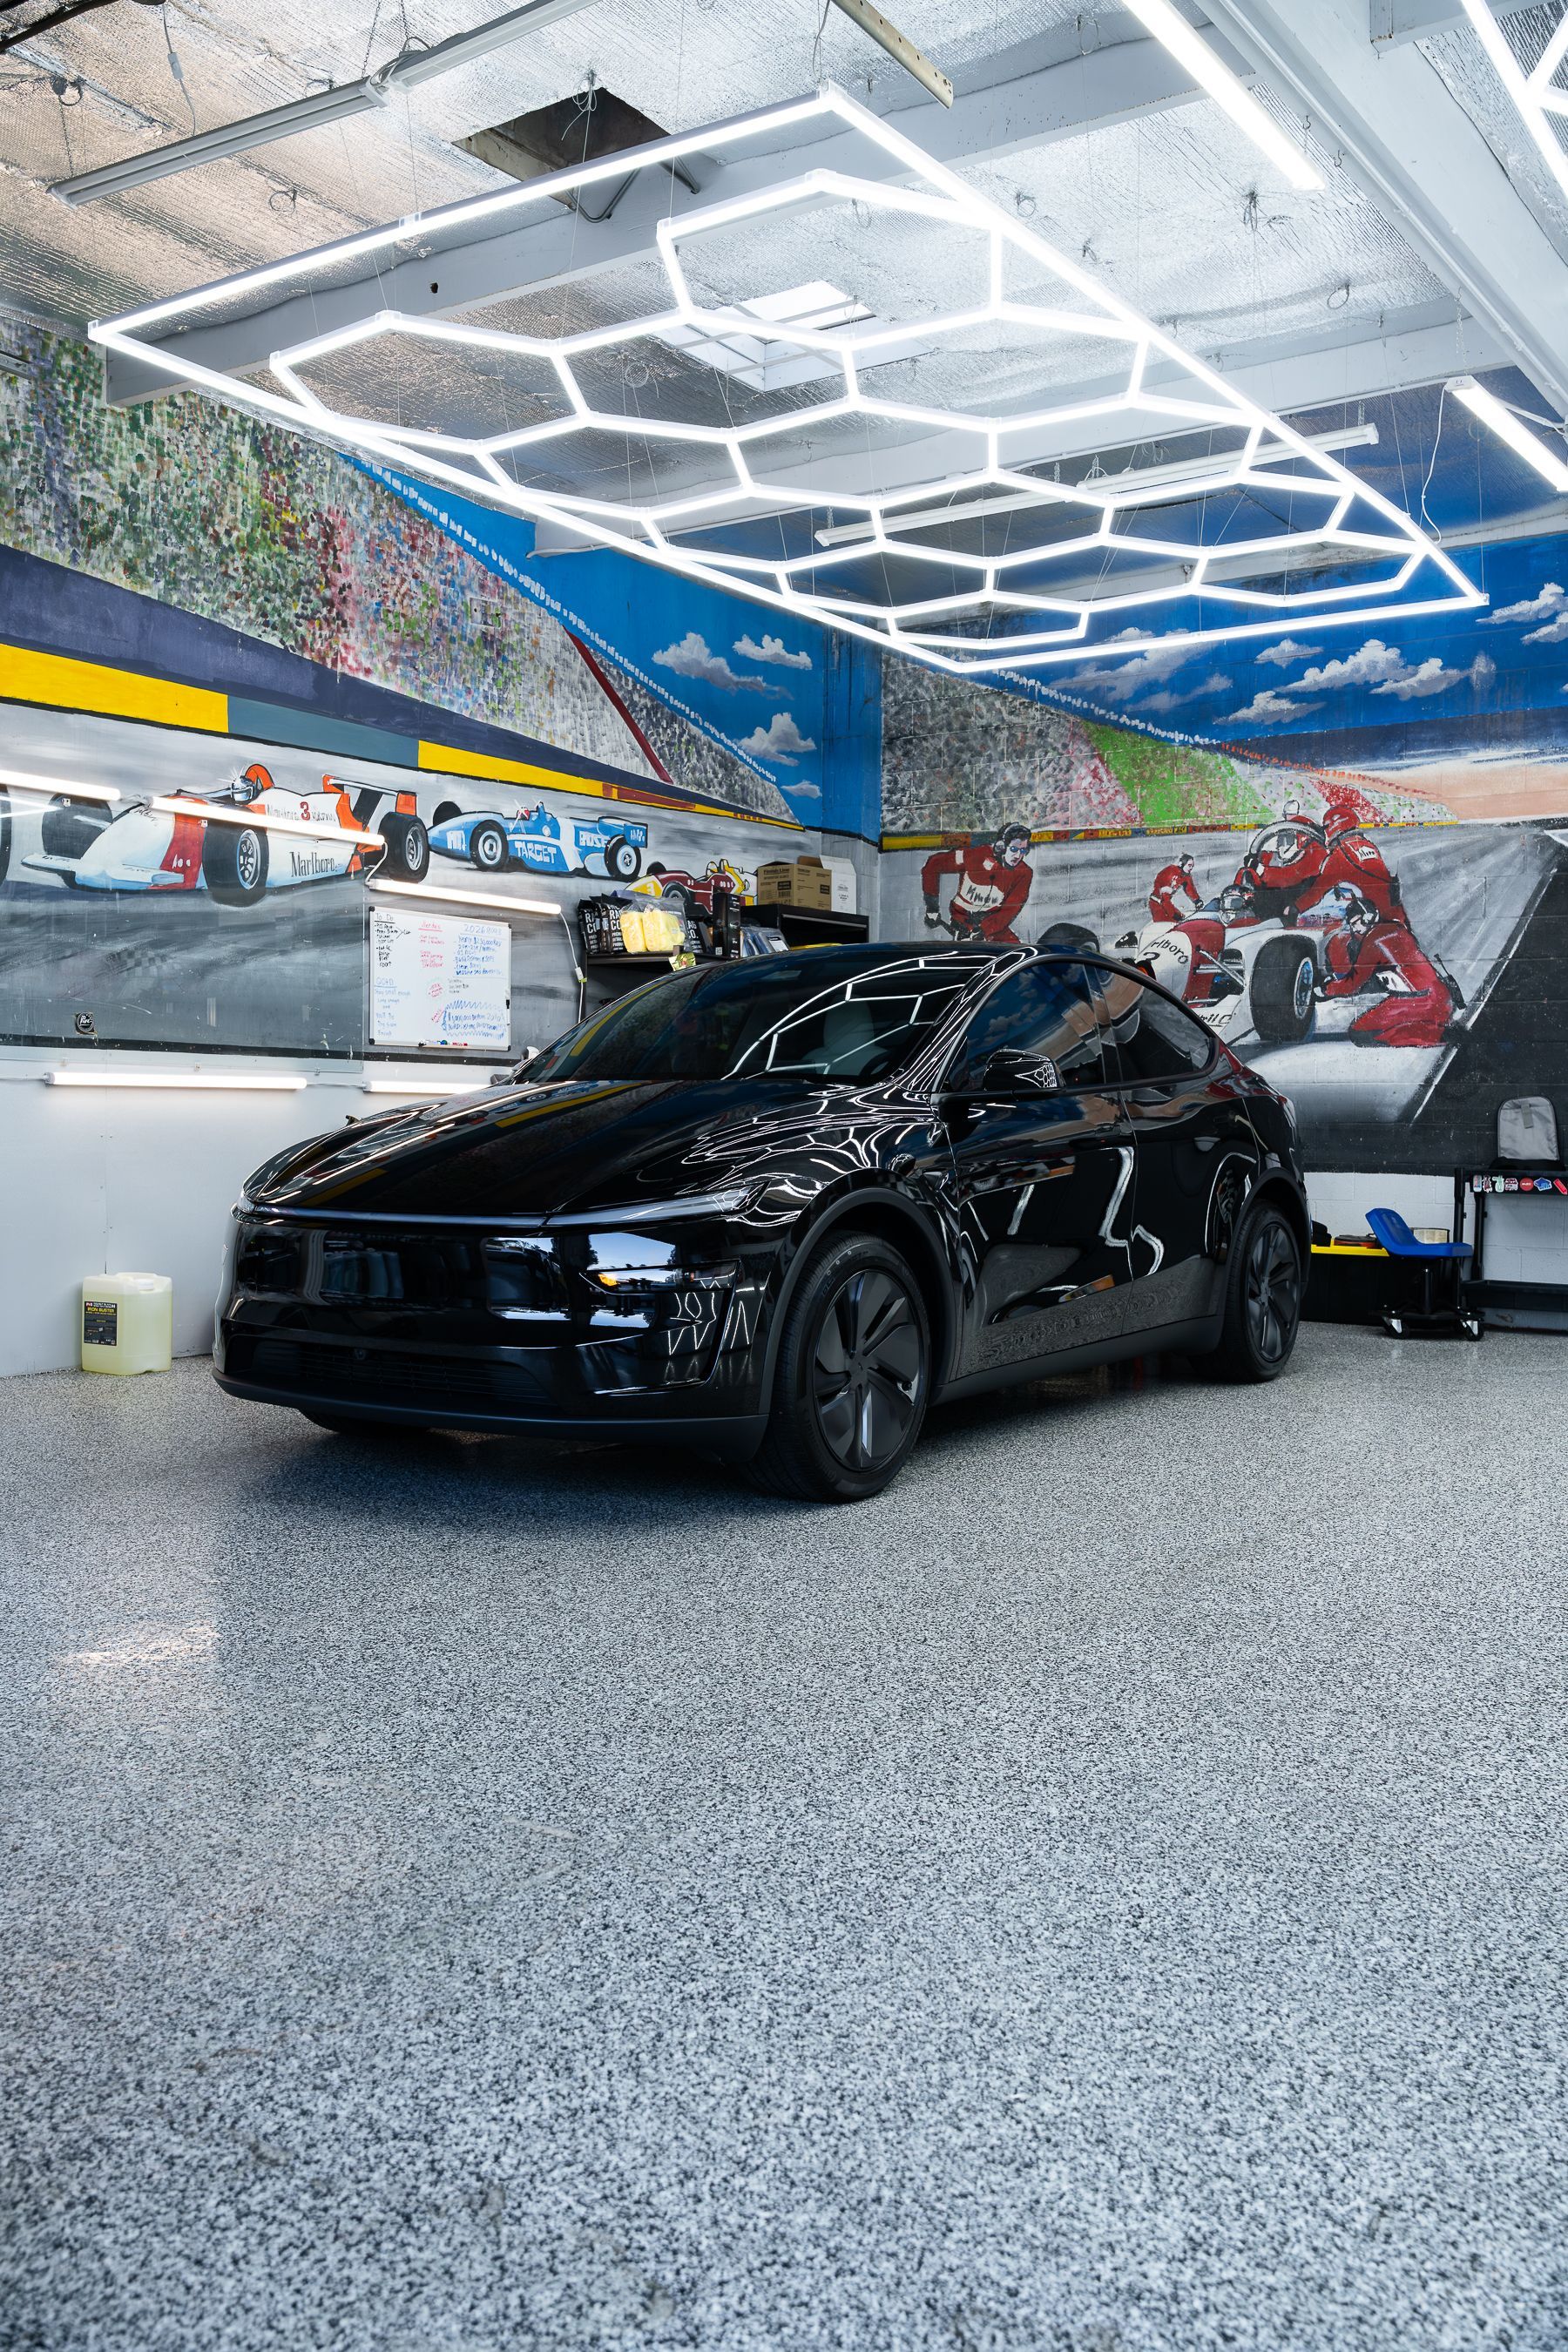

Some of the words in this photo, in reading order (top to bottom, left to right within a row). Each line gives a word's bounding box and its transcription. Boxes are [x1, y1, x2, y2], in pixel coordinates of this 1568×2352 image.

[300, 801, 311, 821] 3
[515, 841, 557, 864] TARGET
[290, 851, 335, 878] Marlboro
